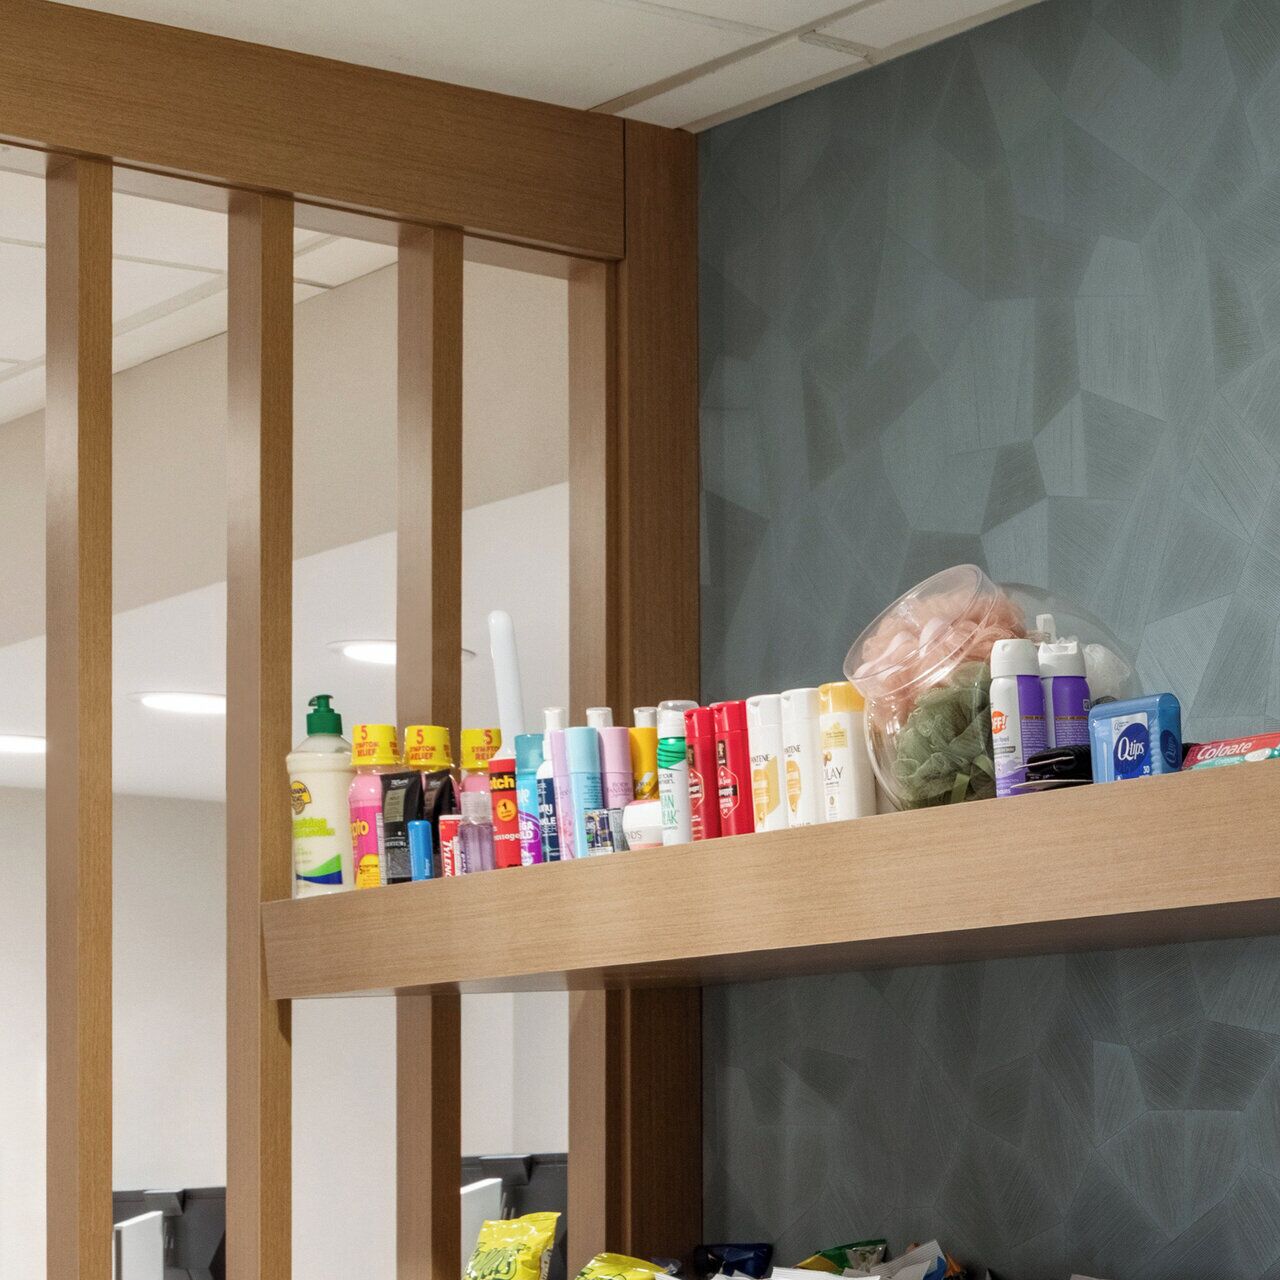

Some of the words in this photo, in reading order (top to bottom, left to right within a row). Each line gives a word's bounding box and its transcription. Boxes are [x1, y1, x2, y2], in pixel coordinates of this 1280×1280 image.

[361, 725, 368, 740] 5
[416, 729, 424, 744] 5
[484, 729, 493, 744] 5
[356, 748, 376, 757] RELIEF
[410, 752, 433, 761] RELIEF
[1117, 737, 1145, 761] Q-tips
[1197, 740, 1252, 761] Colgate
